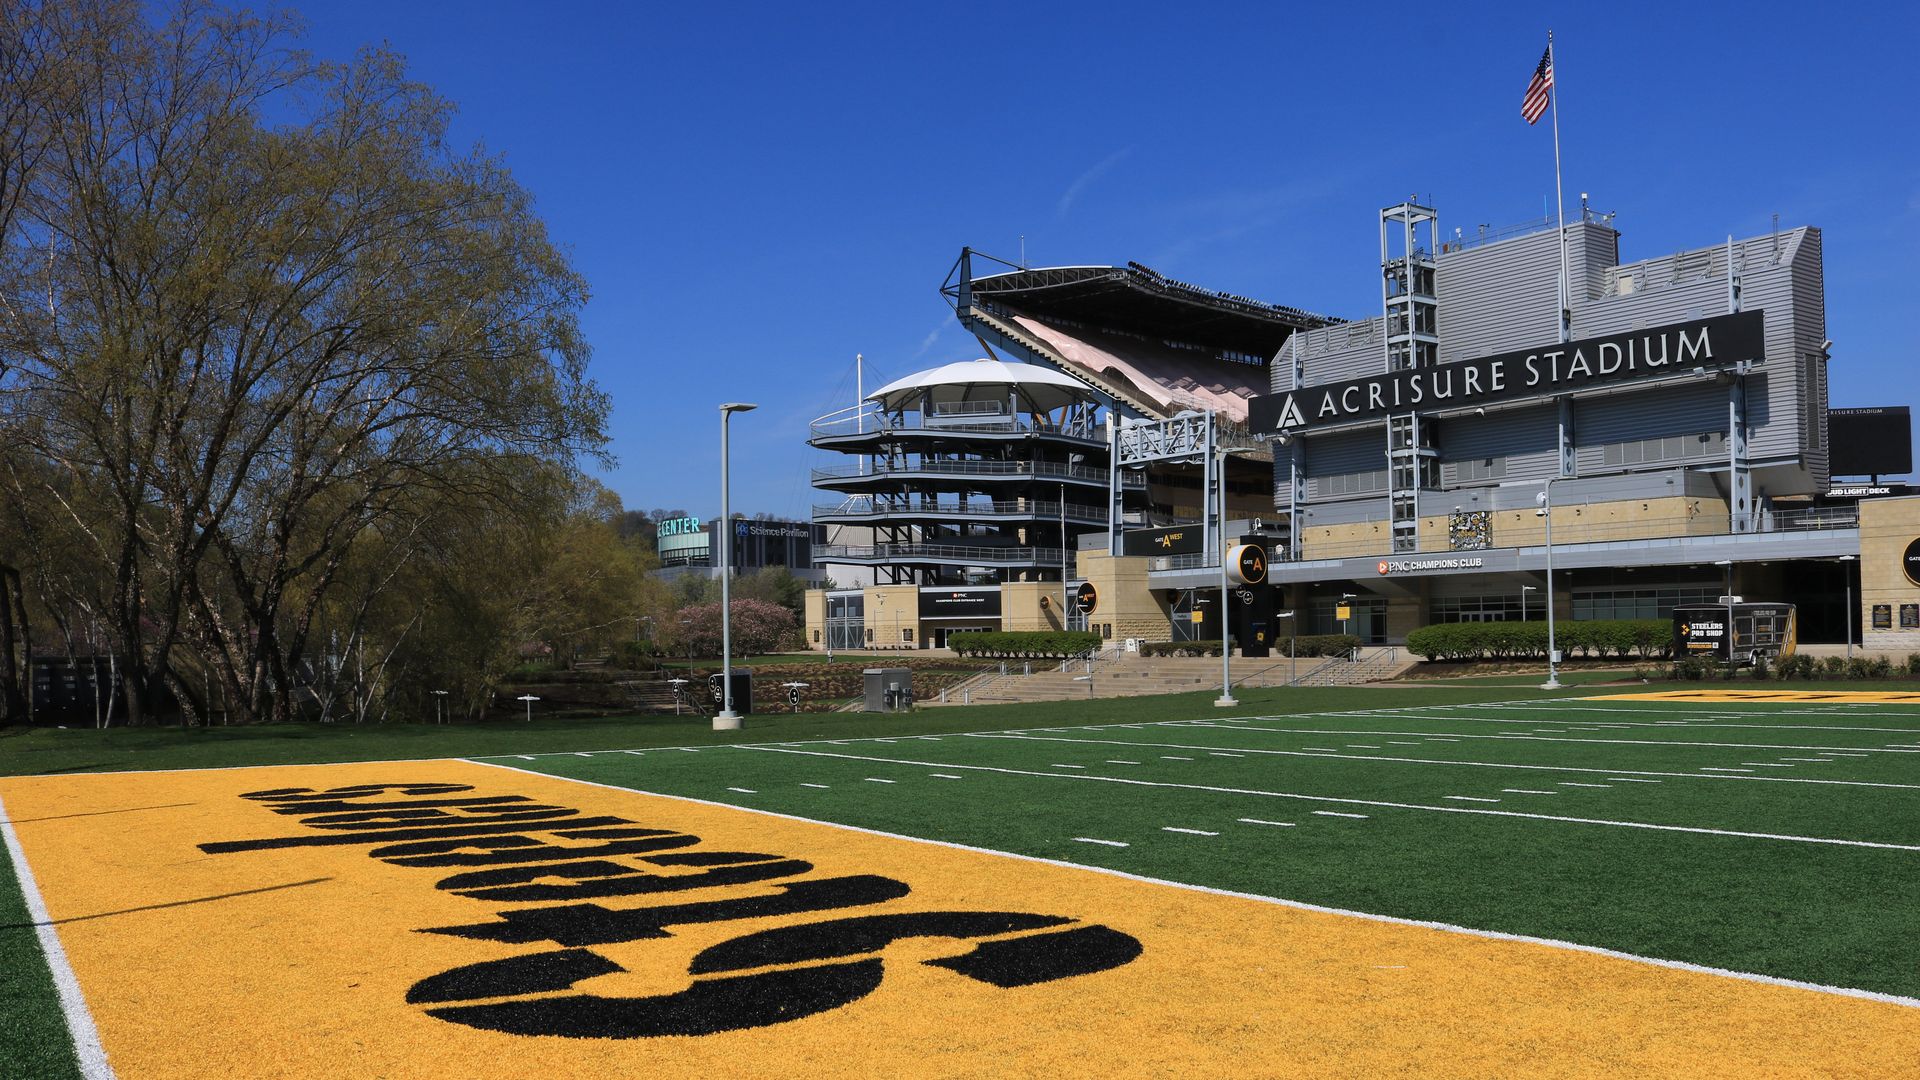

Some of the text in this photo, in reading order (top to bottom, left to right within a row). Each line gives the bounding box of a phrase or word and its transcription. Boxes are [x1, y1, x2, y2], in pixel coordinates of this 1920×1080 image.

[1317, 360, 1506, 418] ACRISURE
[1525, 325, 1714, 387] STADIUM
[661, 516, 700, 537] CENTER
[749, 526, 780, 536] Science
[780, 527, 809, 538] Pavilion
[1162, 534, 1171, 548] A
[1253, 557, 1263, 571] A
[1388, 557, 1482, 572] PNC CHAMPIONS CLUB
[197, 782, 1143, 1038] Steelers
